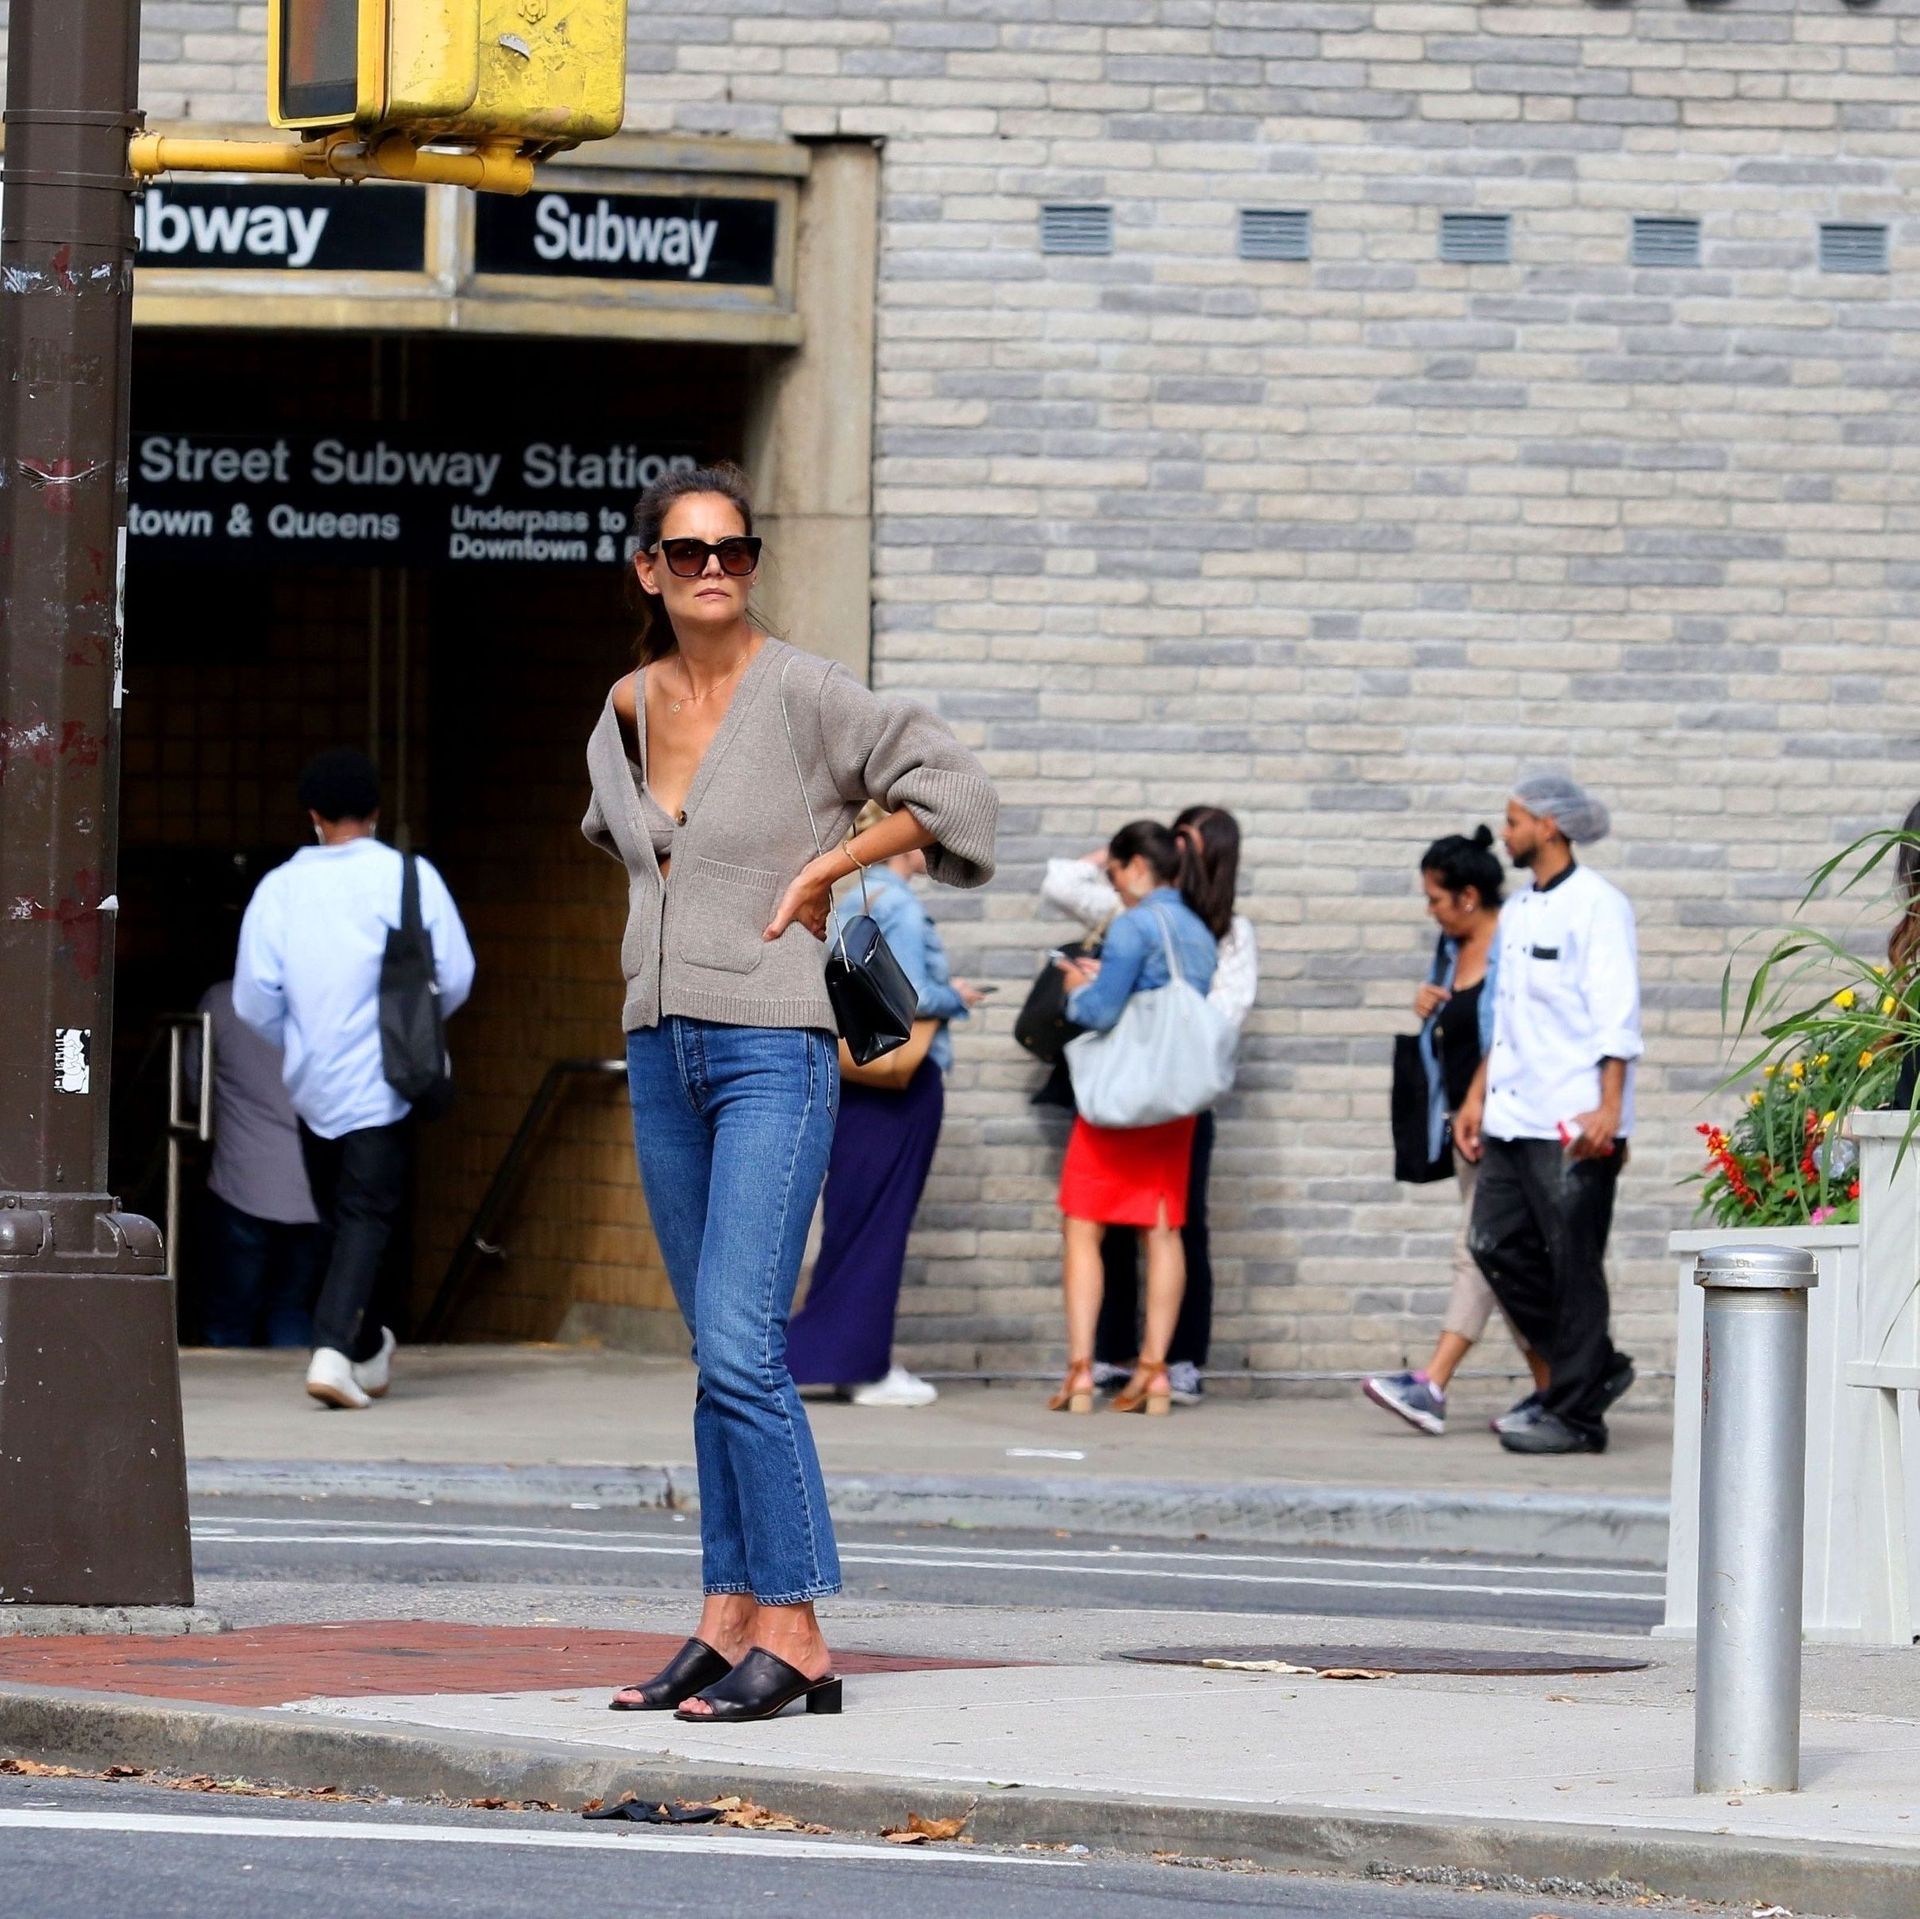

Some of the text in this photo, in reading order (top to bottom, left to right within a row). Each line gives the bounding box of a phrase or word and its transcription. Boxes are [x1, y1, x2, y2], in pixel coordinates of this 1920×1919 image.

[135, 189, 329, 267] bway
[533, 193, 719, 279] Subway
[140, 436, 290, 483] Street
[311, 438, 501, 497] Subway
[227, 502, 252, 538] &
[267, 504, 400, 540] Queens
[451, 504, 627, 538] Underpass to
[449, 532, 588, 562] Downtown
[595, 534, 616, 562] &
